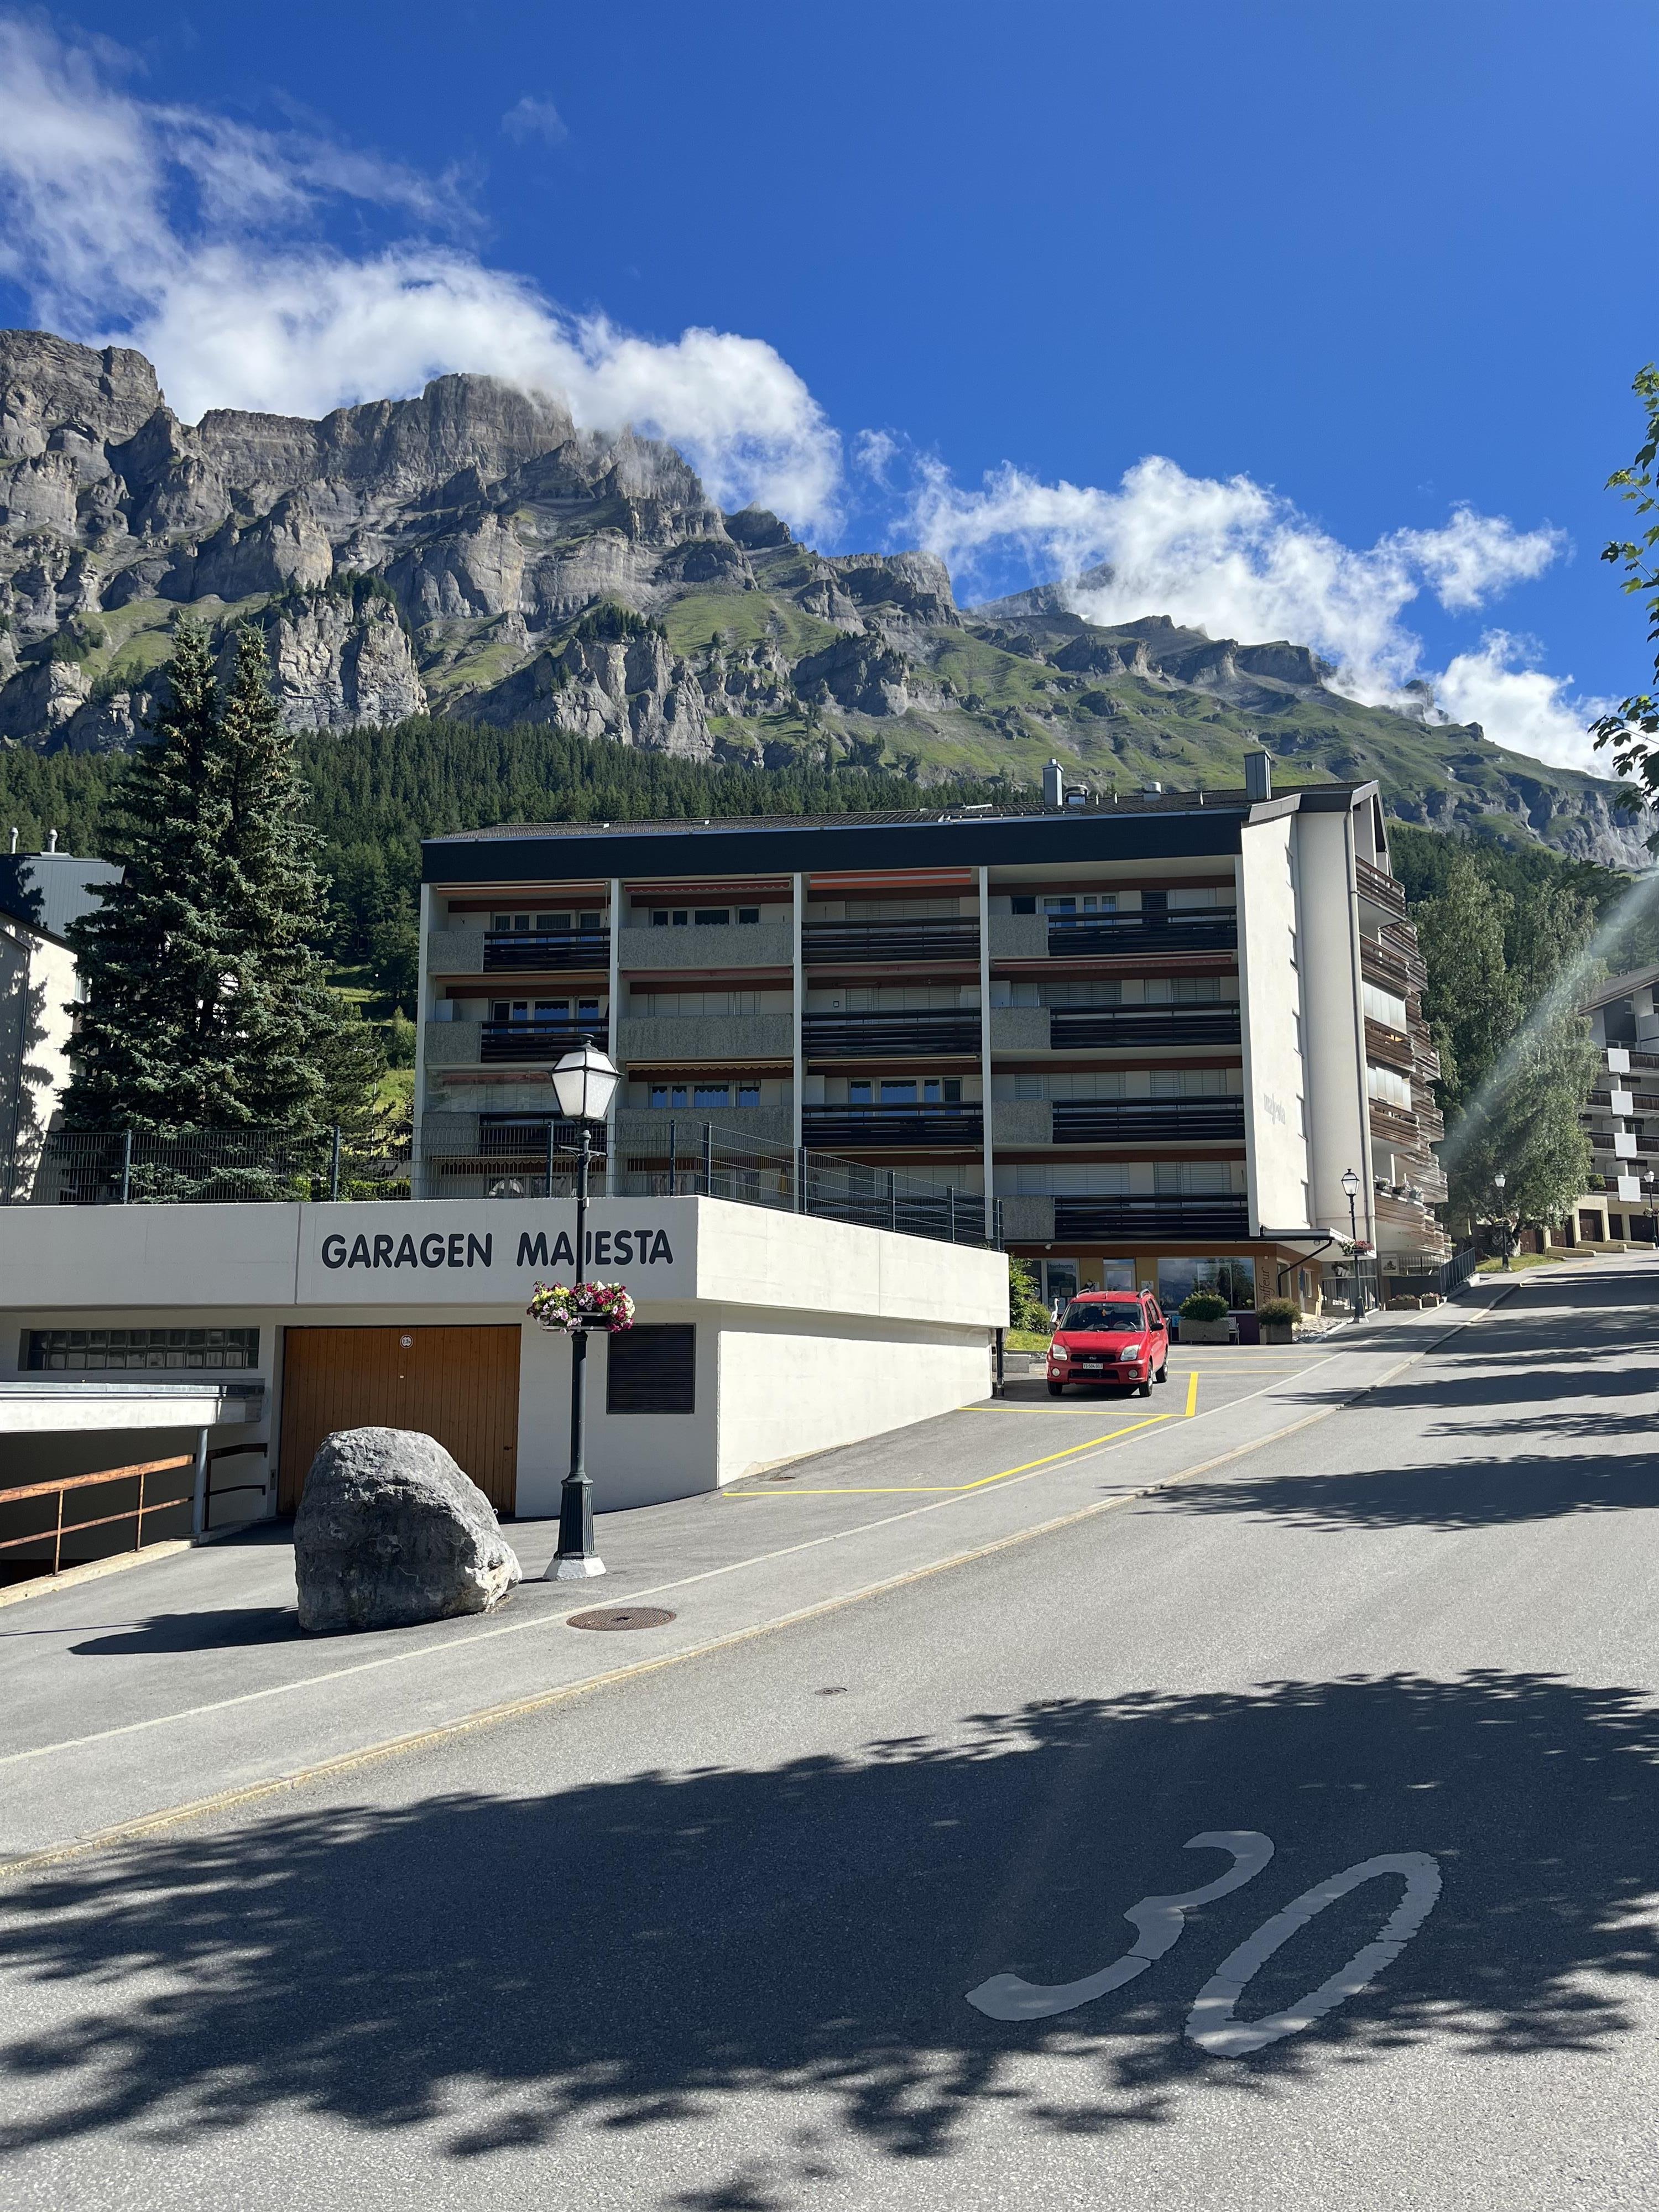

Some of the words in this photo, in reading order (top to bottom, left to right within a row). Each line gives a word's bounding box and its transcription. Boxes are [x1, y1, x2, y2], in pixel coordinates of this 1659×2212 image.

[1263, 1092, 1286, 1125] majesta
[322, 1233, 492, 1269] GARAGEN
[517, 1229, 673, 1266] MAJESTA
[1259, 1266, 1275, 1304] oiffeur
[965, 1830, 1442, 2058] 30
